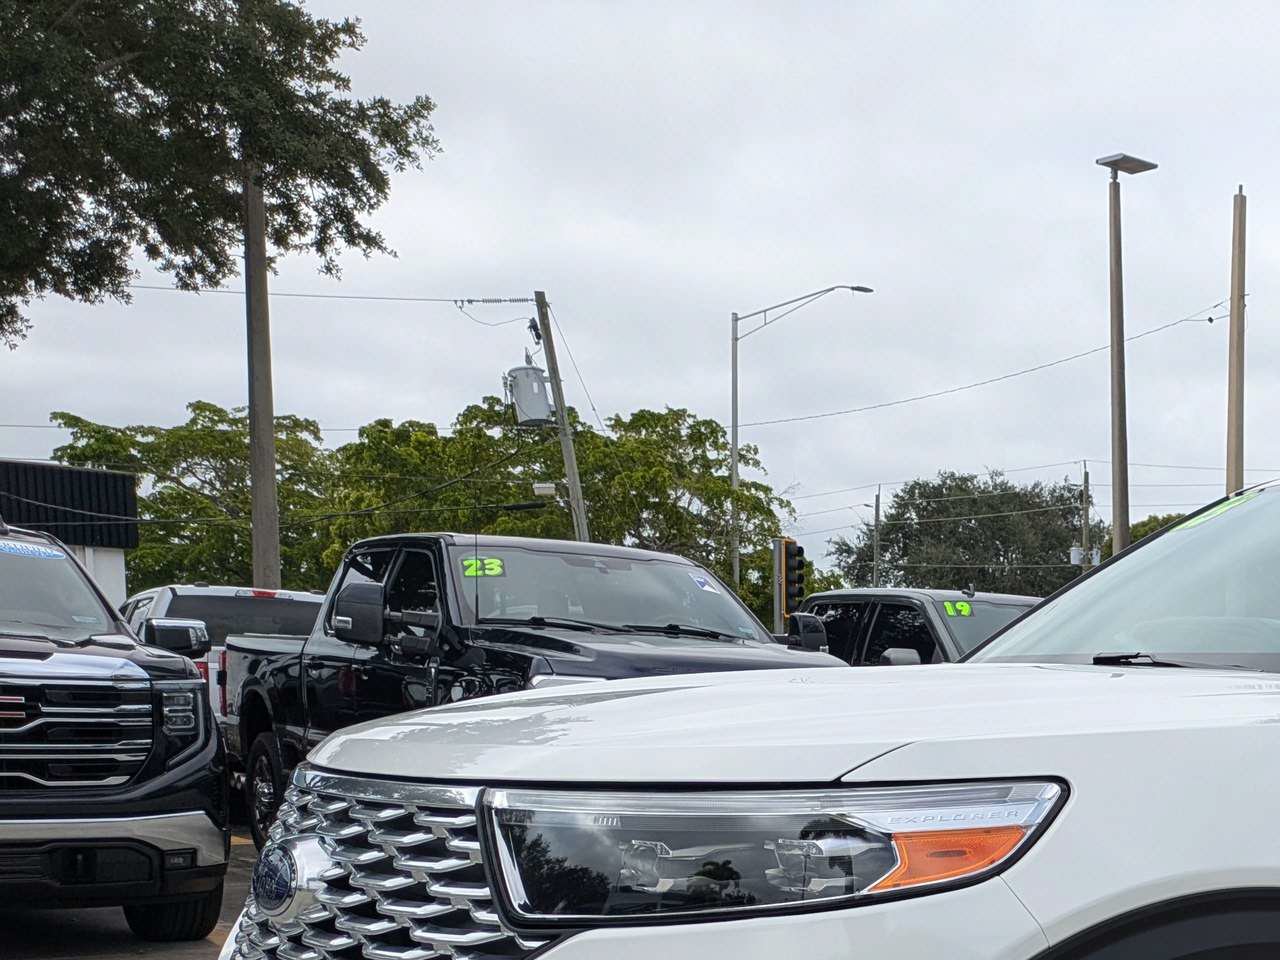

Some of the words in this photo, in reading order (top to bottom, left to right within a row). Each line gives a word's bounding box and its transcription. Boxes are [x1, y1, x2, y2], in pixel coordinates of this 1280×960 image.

[463, 558, 504, 576] 23
[943, 601, 970, 616] 19
[888, 810, 1019, 824] EXPLORER
